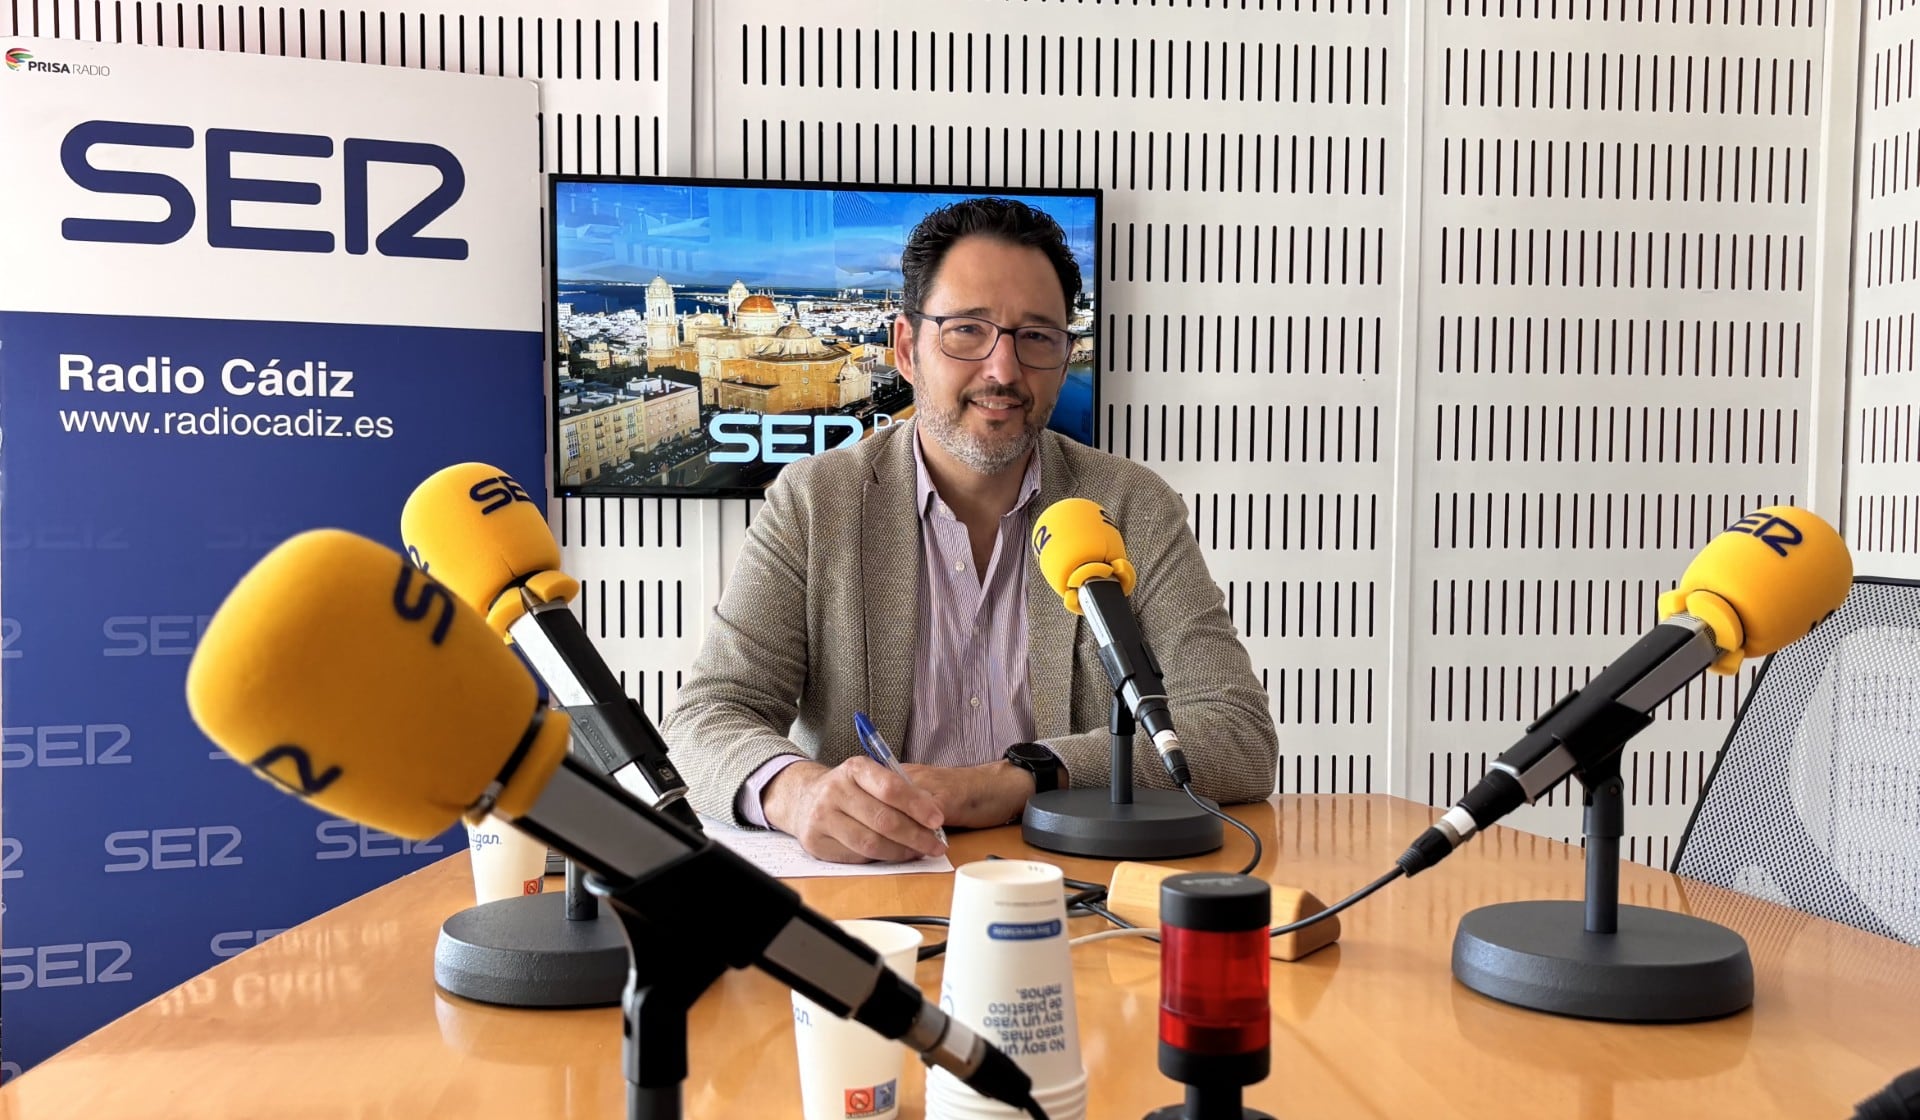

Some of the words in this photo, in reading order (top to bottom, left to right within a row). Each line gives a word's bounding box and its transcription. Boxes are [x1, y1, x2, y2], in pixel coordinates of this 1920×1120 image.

[28, 60, 71, 74] PRISA
[72, 63, 111, 77] RADIO
[60, 119, 469, 261] SER
[58, 353, 205, 395] Radio
[221, 358, 354, 398] Cádiz
[58, 406, 394, 439] www.radiocadiz.es
[469, 476, 532, 515] SE
[1724, 512, 1803, 557] ER
[103, 615, 209, 657] SE
[104, 825, 244, 873] SER
[983, 1016, 1019, 1028] vaso
[1035, 1024, 1064, 1039] vaso
[1022, 1041, 1047, 1055] soy
